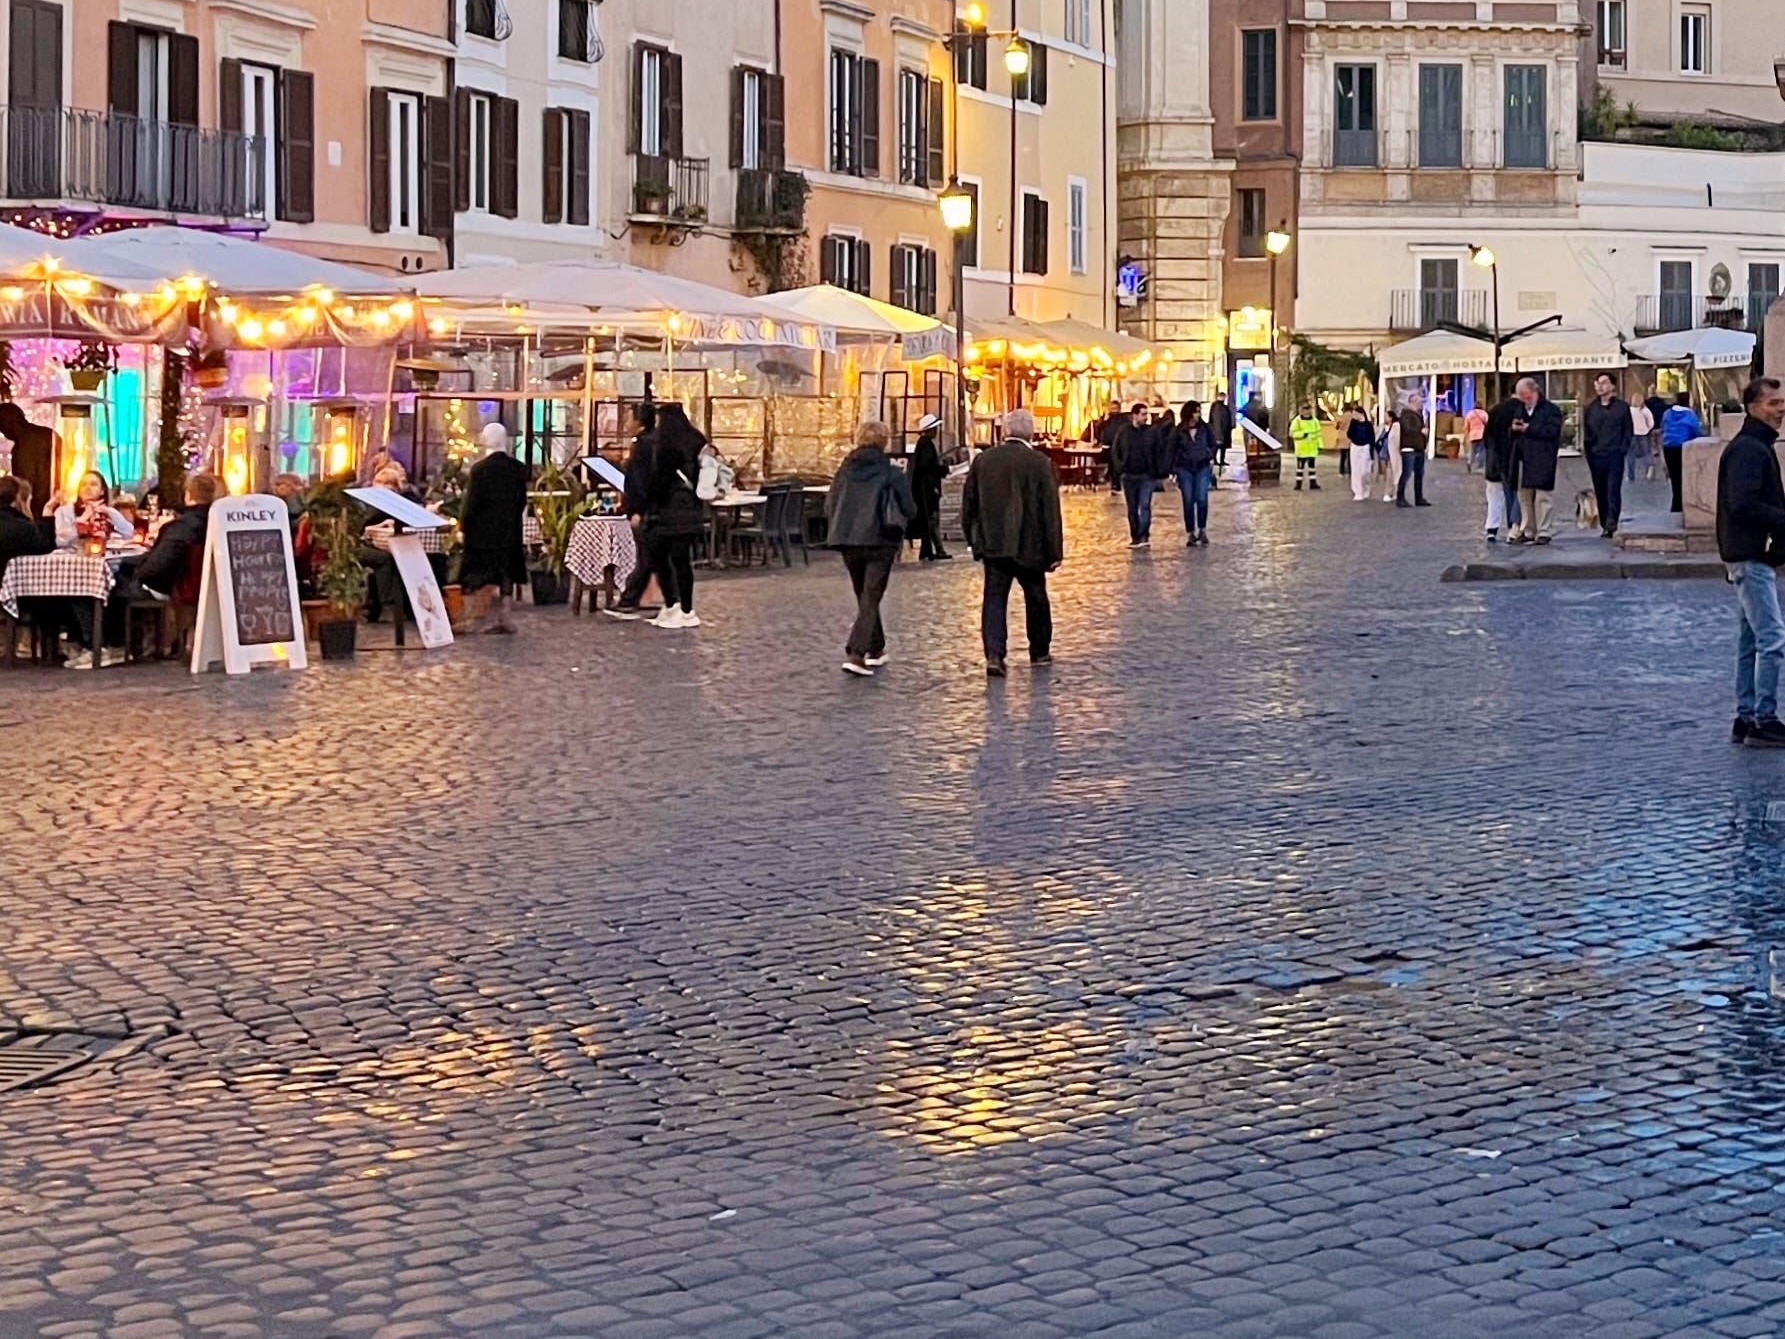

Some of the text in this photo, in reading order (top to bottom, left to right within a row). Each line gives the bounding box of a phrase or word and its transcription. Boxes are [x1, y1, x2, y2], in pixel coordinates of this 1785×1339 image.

[1452, 359, 1513, 369] HOSTAIA
[1537, 356, 1614, 366] RISTORANTE
[1382, 363, 1440, 374] MERCATO
[226, 509, 277, 522] KINLEY
